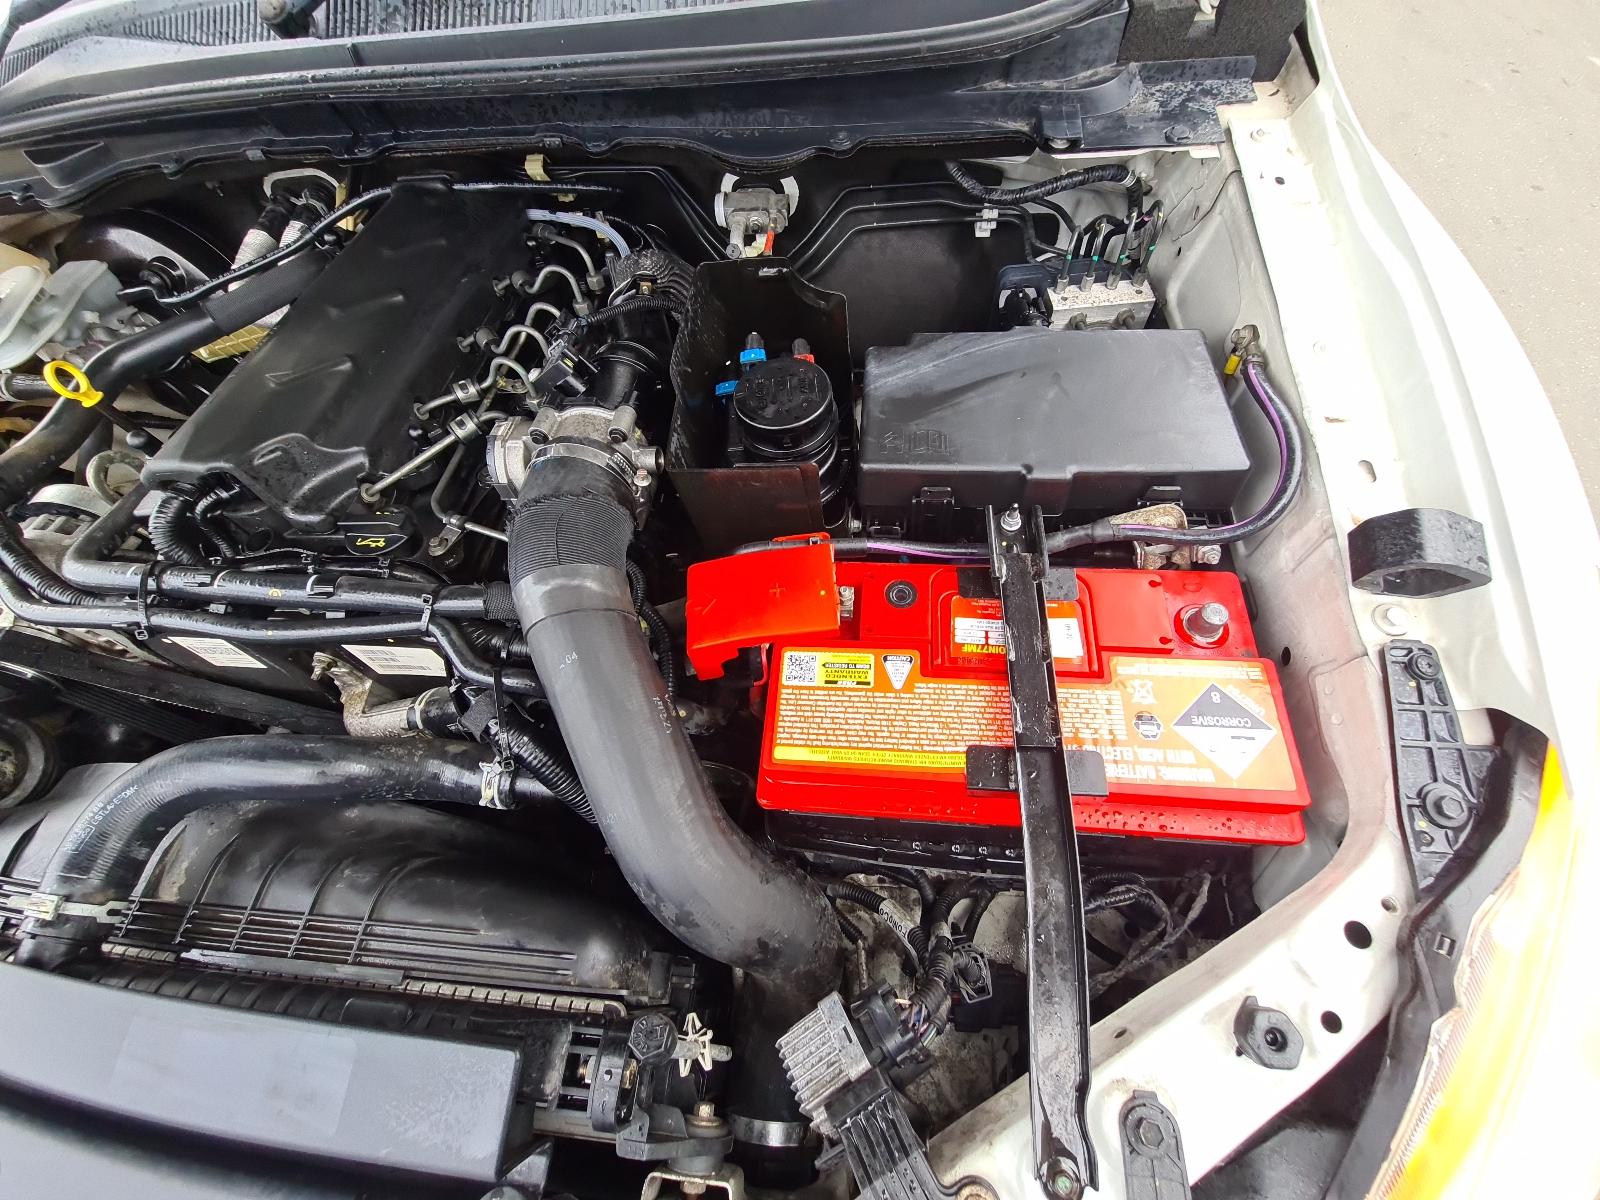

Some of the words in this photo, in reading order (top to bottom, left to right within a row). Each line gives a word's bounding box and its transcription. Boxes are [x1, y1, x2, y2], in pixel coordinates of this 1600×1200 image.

[1210, 691, 1221, 704] 8
[1190, 715, 1252, 728] CORROSIVE
[1104, 763, 1157, 780] BATTERIE
[879, 908, 909, 940] FoMoCo
